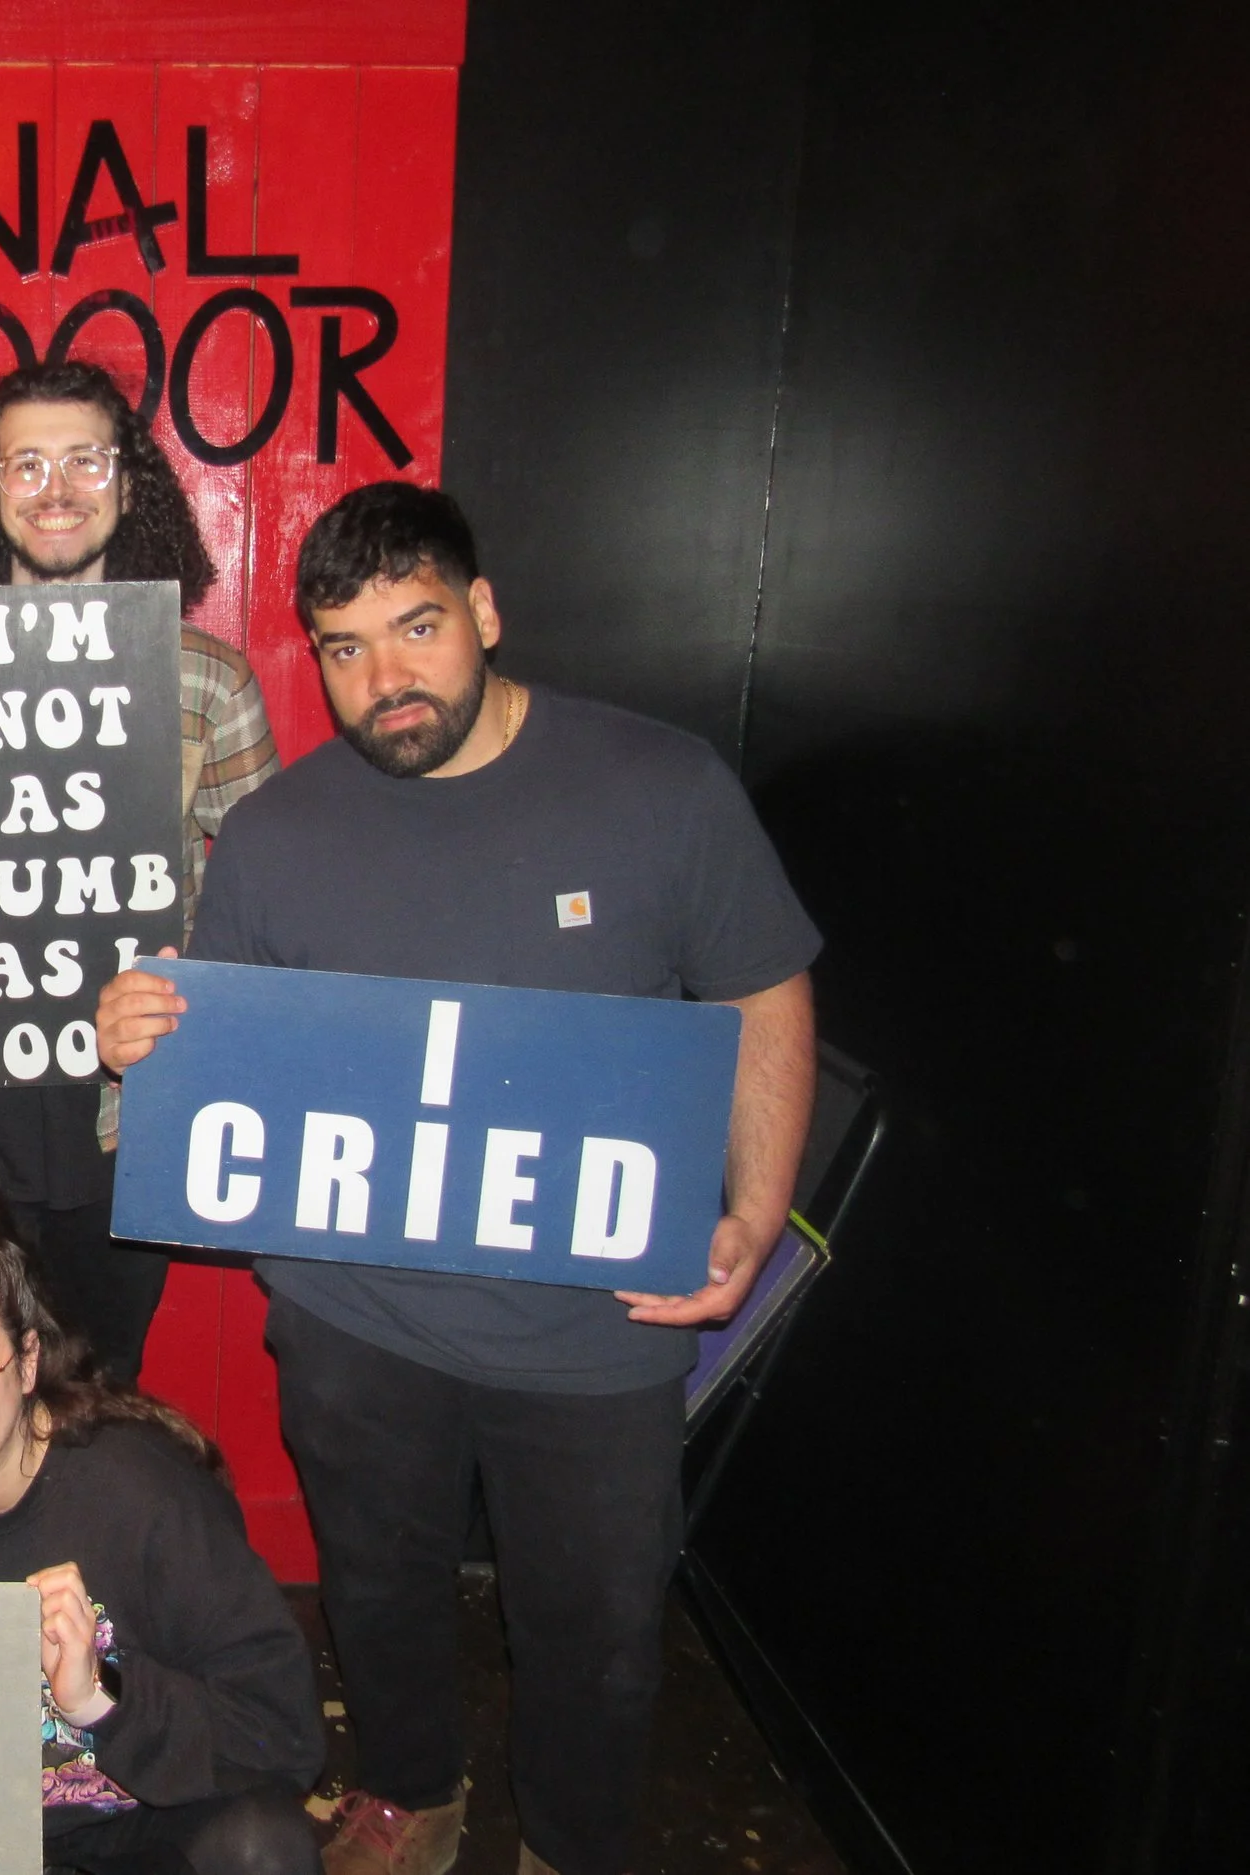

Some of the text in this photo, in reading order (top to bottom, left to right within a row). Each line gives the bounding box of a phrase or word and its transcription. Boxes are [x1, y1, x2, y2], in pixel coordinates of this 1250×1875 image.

[0, 771, 106, 835] AS
[420, 1000, 461, 1106] I
[185, 1101, 658, 1260] CRIED
